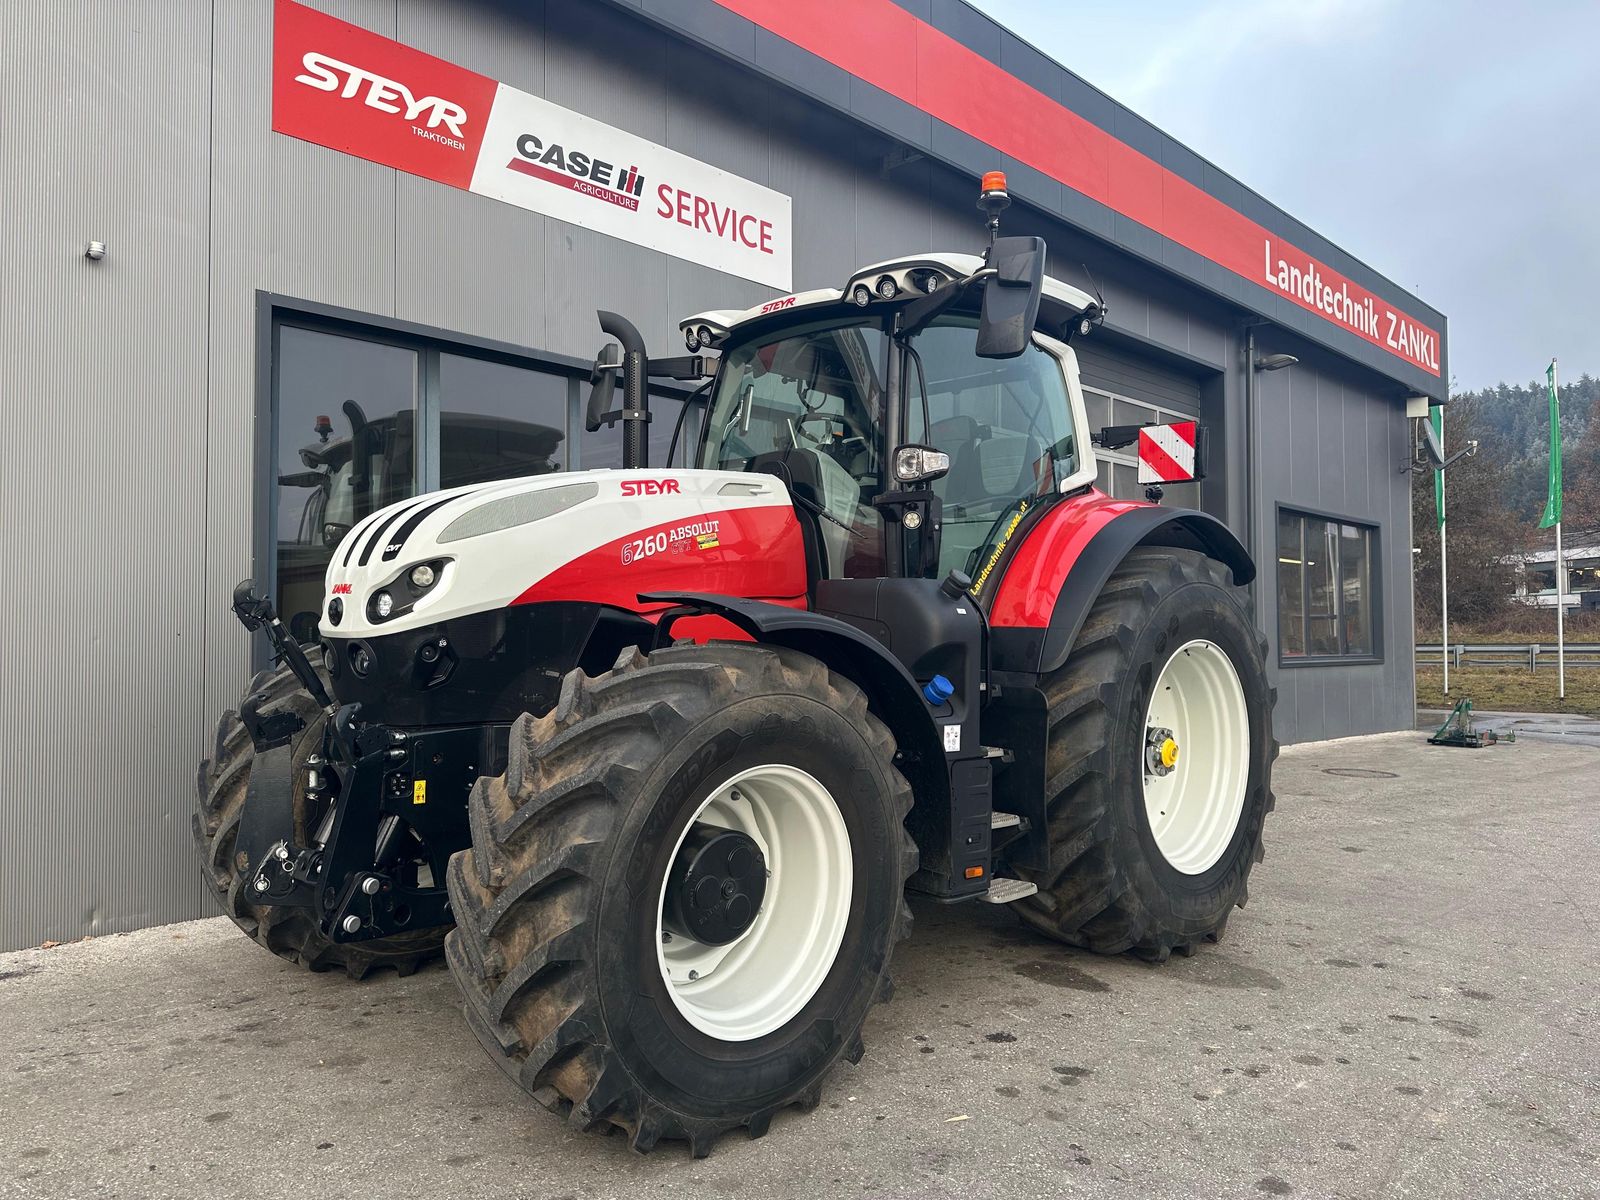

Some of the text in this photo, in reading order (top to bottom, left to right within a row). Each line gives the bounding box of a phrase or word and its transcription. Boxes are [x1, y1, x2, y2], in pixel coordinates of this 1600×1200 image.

[294, 52, 467, 139] STEYR
[412, 125, 465, 151] TRAKTOREN
[516, 133, 614, 186] CASE
[657, 184, 774, 255] SERVICE
[573, 181, 636, 210] AGRICULTURE
[760, 297, 796, 314] STEYR
[1265, 239, 1439, 371] Landtechnik ZANKL
[620, 479, 681, 496] STEYR
[385, 543, 403, 553] CVT
[621, 532, 667, 566] 6260
[669, 520, 719, 542] ABSOLUT
